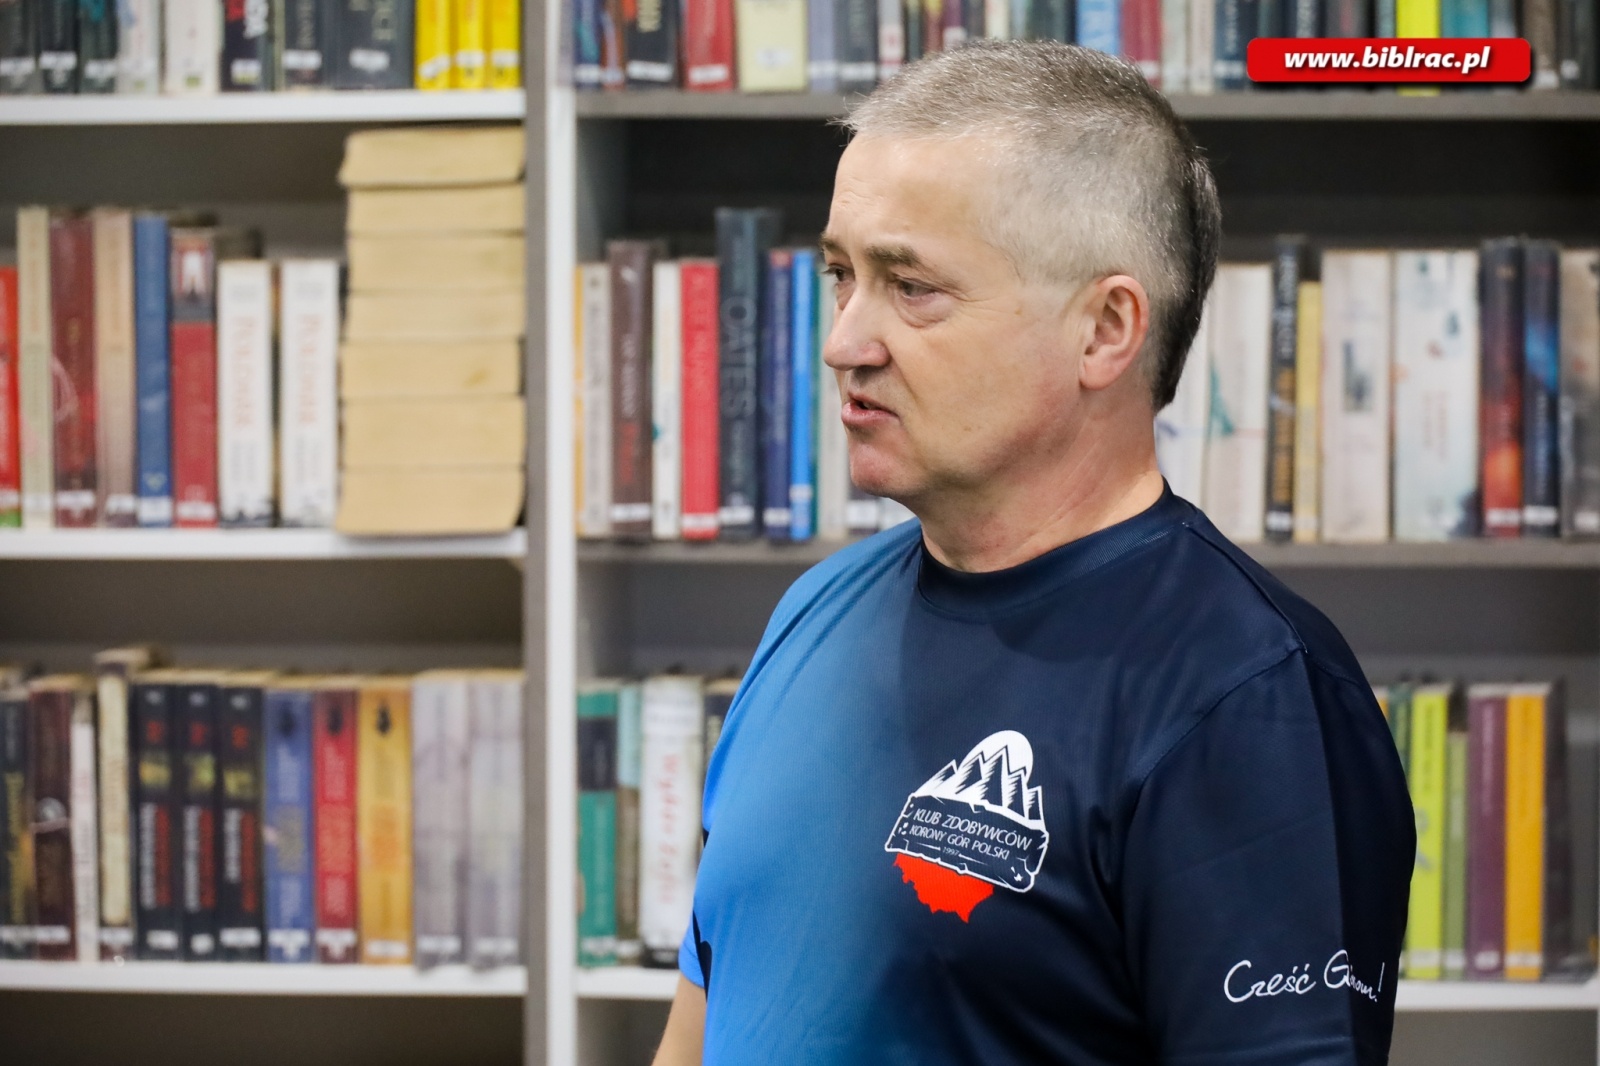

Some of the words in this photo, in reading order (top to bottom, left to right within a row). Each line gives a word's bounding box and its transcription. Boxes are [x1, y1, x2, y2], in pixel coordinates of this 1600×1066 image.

[720, 296, 756, 419] OATES
[909, 824, 947, 841] KORONY
[947, 832, 970, 849] GÓR
[972, 842, 1010, 860] POLSKI
[914, 808, 941, 825] KLUB
[942, 814, 1032, 851] ZDOBYWCÓW
[943, 846, 960, 856] 1997
[1224, 959, 1317, 1003] Cześć
